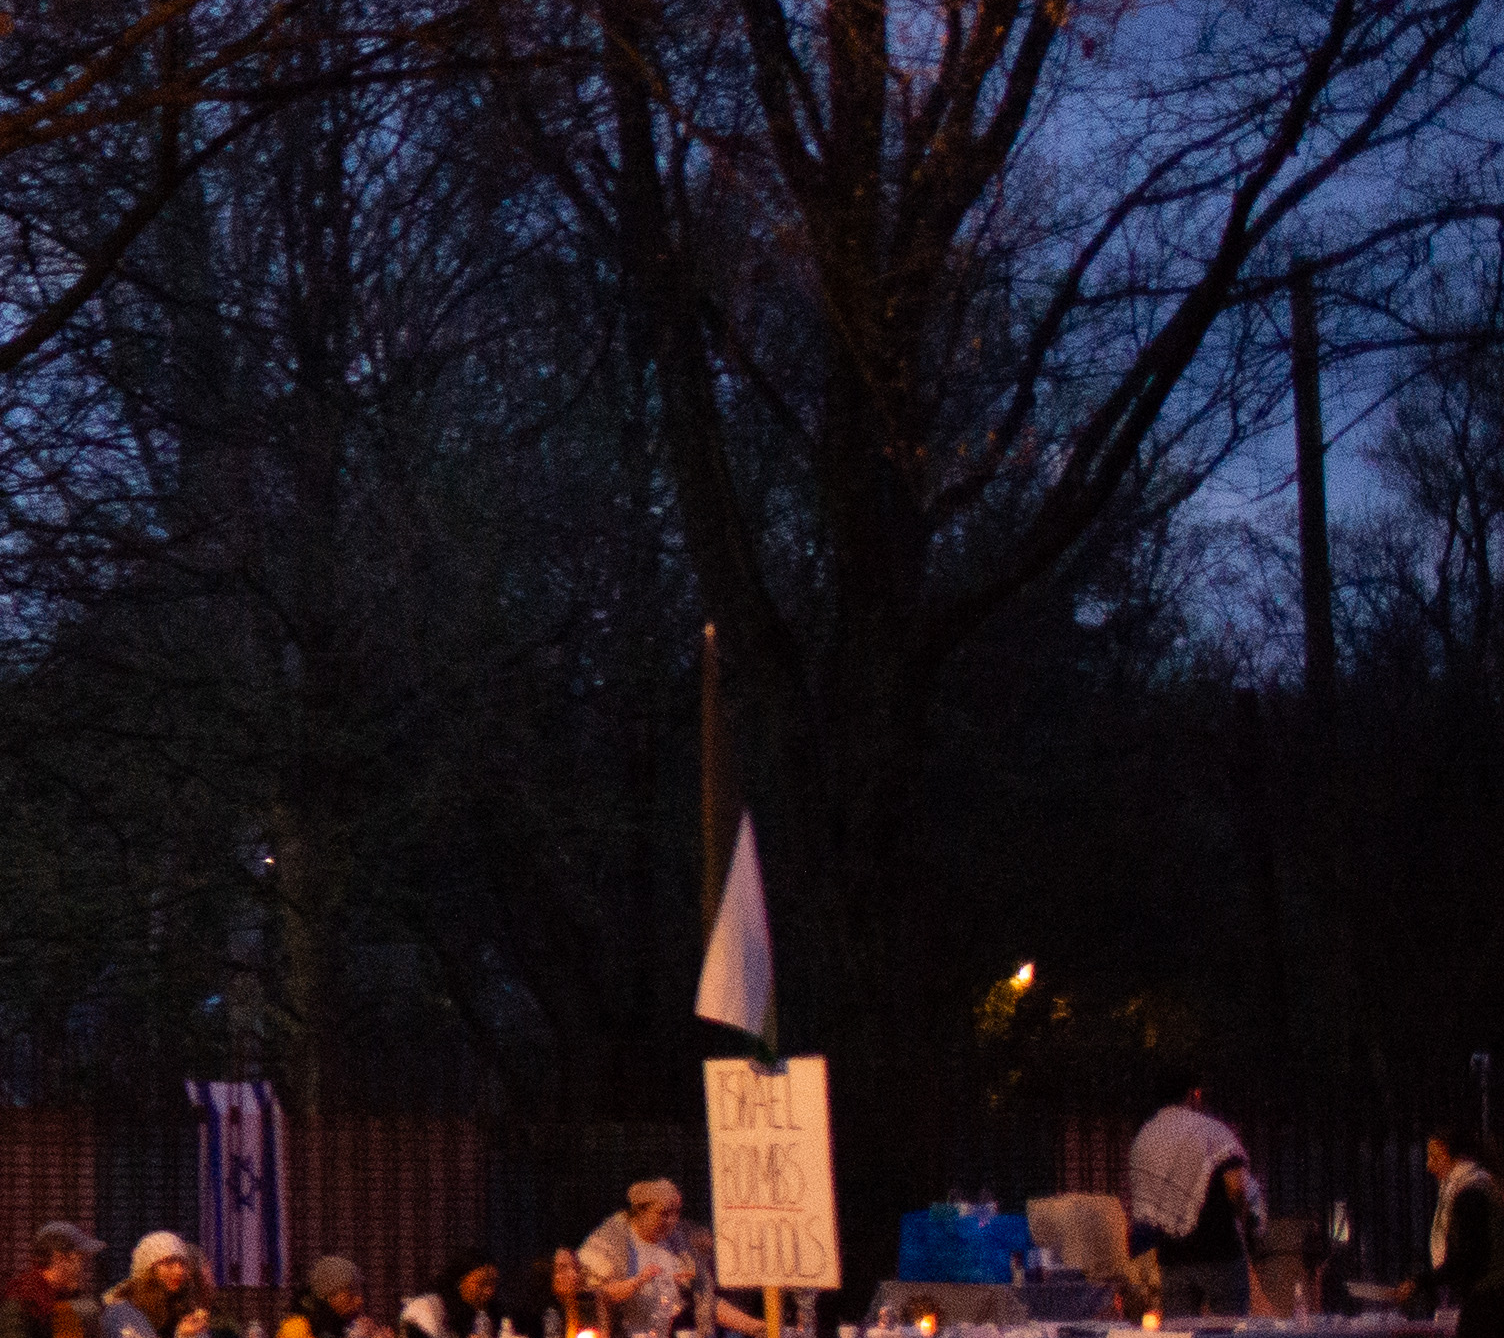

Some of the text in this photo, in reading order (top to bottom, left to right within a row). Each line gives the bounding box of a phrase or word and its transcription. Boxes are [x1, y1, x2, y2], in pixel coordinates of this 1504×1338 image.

[716, 1069, 803, 1131] ISRAEL
[720, 1142, 808, 1206] BOMBS
[718, 1215, 828, 1279] SCHOOLS
